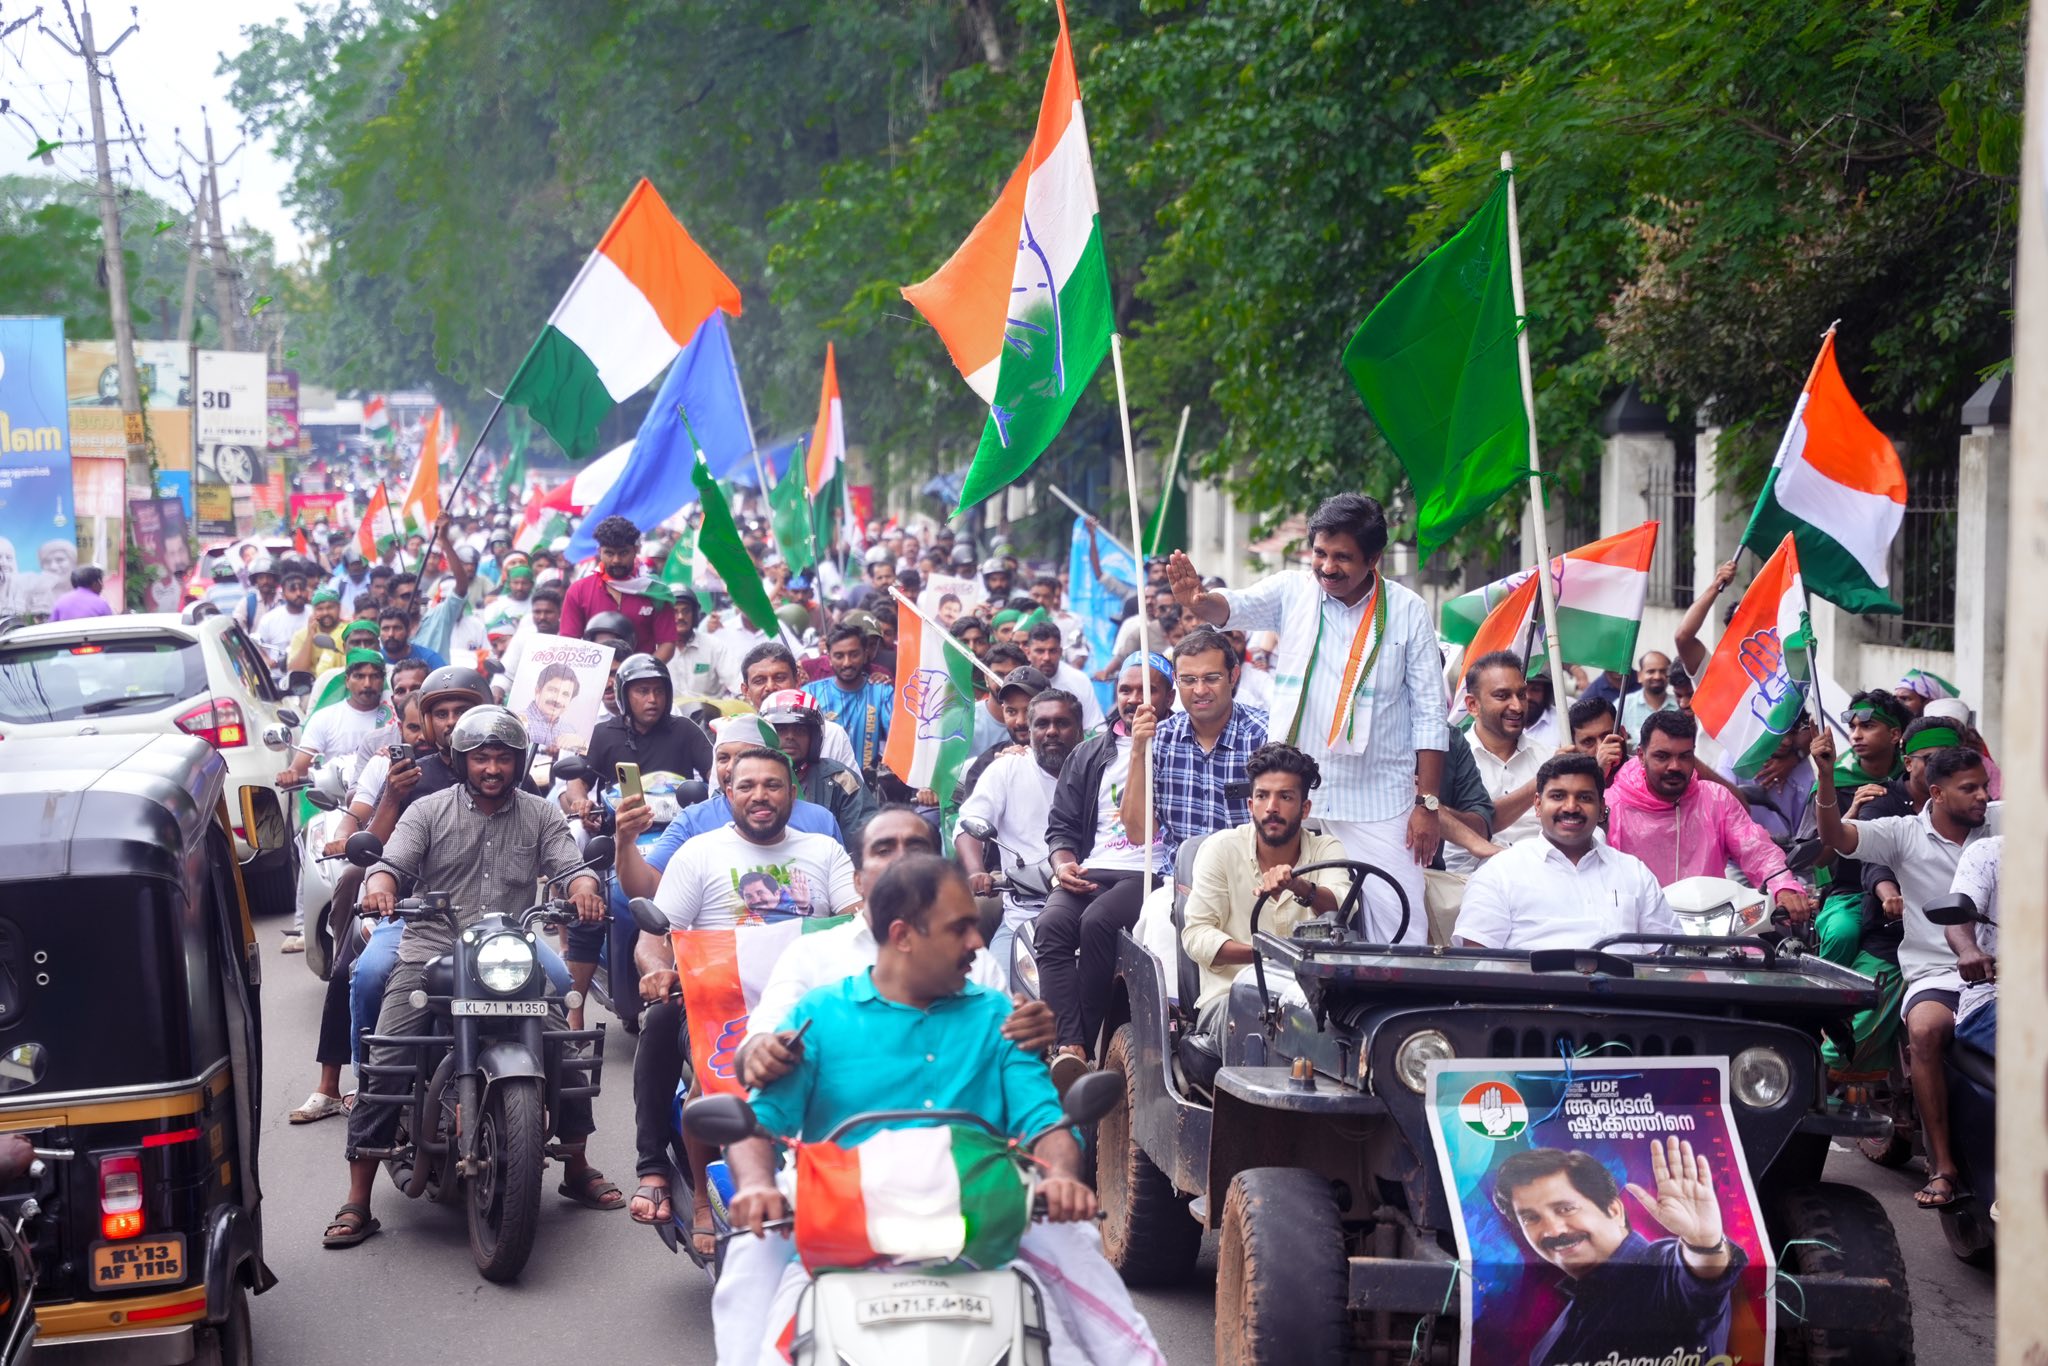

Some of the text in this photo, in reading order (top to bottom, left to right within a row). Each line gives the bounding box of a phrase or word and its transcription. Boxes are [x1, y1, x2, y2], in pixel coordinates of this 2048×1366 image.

[202, 391, 231, 408] 3D
[465, 1003, 479, 1014] KL
[485, 1003, 498, 1013] 71
[519, 1003, 546, 1014] 1350
[1591, 1081, 1618, 1093] UDF
[1565, 1093, 1655, 1117] ആര്യാടൻ
[146, 1246, 169, 1261] 13
[100, 1260, 178, 1280] AF 1115
